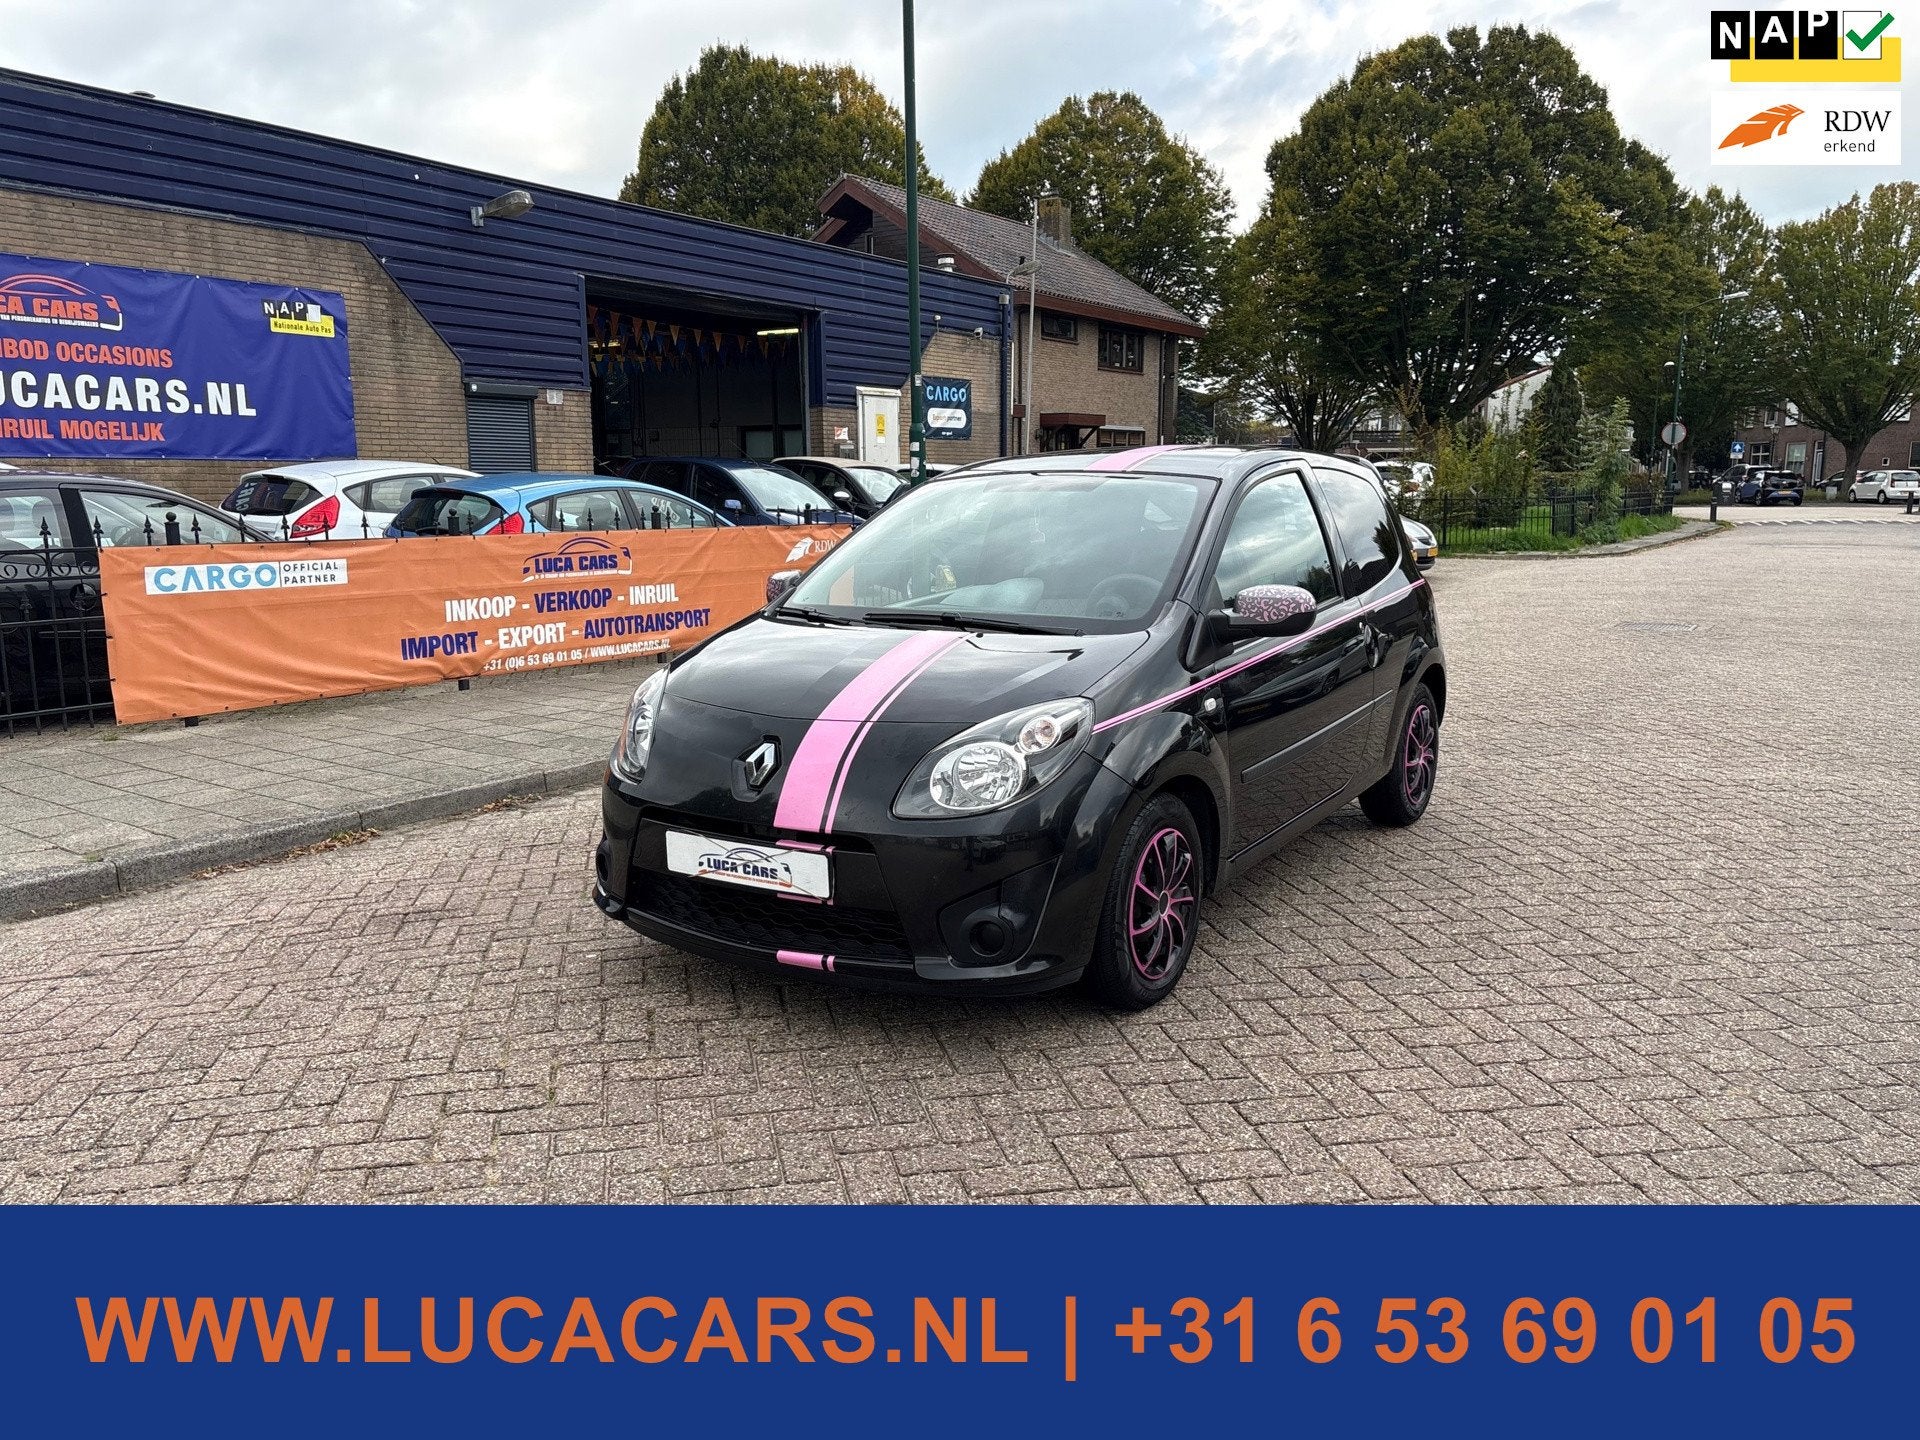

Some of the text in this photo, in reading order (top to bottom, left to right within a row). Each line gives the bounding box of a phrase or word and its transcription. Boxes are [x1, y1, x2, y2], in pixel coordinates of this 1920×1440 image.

[33, 297, 98, 320] CARS
[263, 301, 304, 315] NAP
[273, 320, 332, 334] Nationale Auto Pas
[0, 338, 173, 369] BOD OCCASIONS
[0, 370, 257, 417] CACARS.NL
[926, 385, 967, 403] CARGO
[0, 418, 165, 441] RUIL MOGELIJK
[814, 539, 837, 553] RDW
[534, 554, 618, 573] LUCA CARS
[153, 561, 339, 592] CARGO OFFICIAL
[283, 573, 337, 585] PARTNER
[444, 595, 517, 623] INKOOP
[533, 587, 613, 613] VERKOOP
[629, 583, 679, 606] INRUIL
[400, 631, 479, 661] IMPORT
[497, 621, 567, 650] EXPORT
[583, 608, 711, 640] AUTOTRANSPORT
[483, 657, 502, 672] +31
[505, 657, 525, 671] (0)6
[527, 653, 540, 666] 53
[542, 652, 554, 664] 69
[556, 650, 568, 662] 01
[570, 649, 582, 661] 05
[590, 638, 671, 658] WWW.LUCACARS.NL
[706, 857, 739, 873] LUCA
[742, 863, 778, 880] CARS
